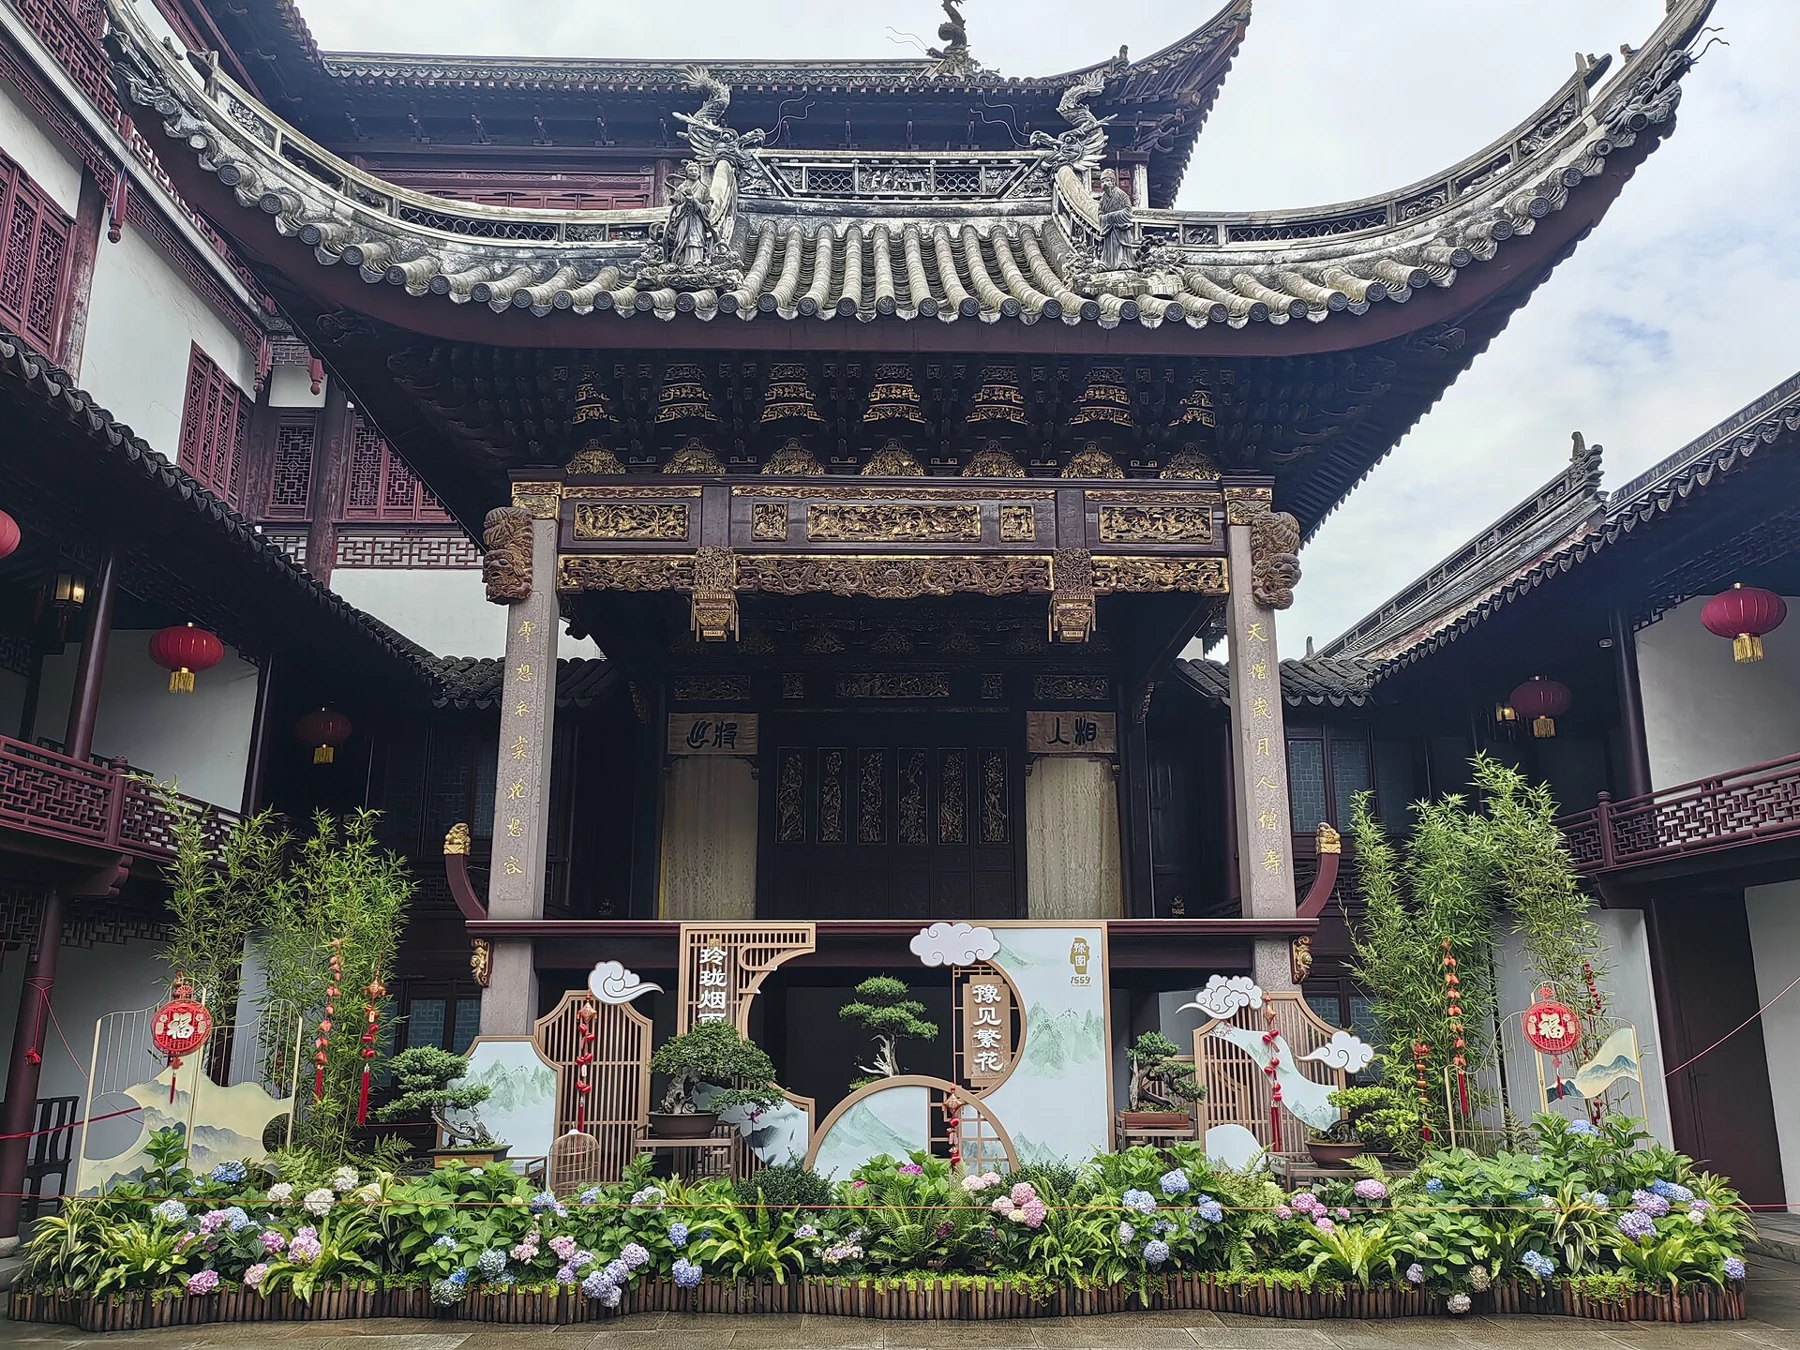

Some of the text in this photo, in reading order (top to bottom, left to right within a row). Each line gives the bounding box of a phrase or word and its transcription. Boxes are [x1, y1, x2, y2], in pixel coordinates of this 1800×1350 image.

[1070, 976, 1091, 984] 1559
[166, 1012, 195, 1039] 福
[972, 983, 1004, 1072] 豫见繁花
[1538, 1013, 1566, 1039] 福
